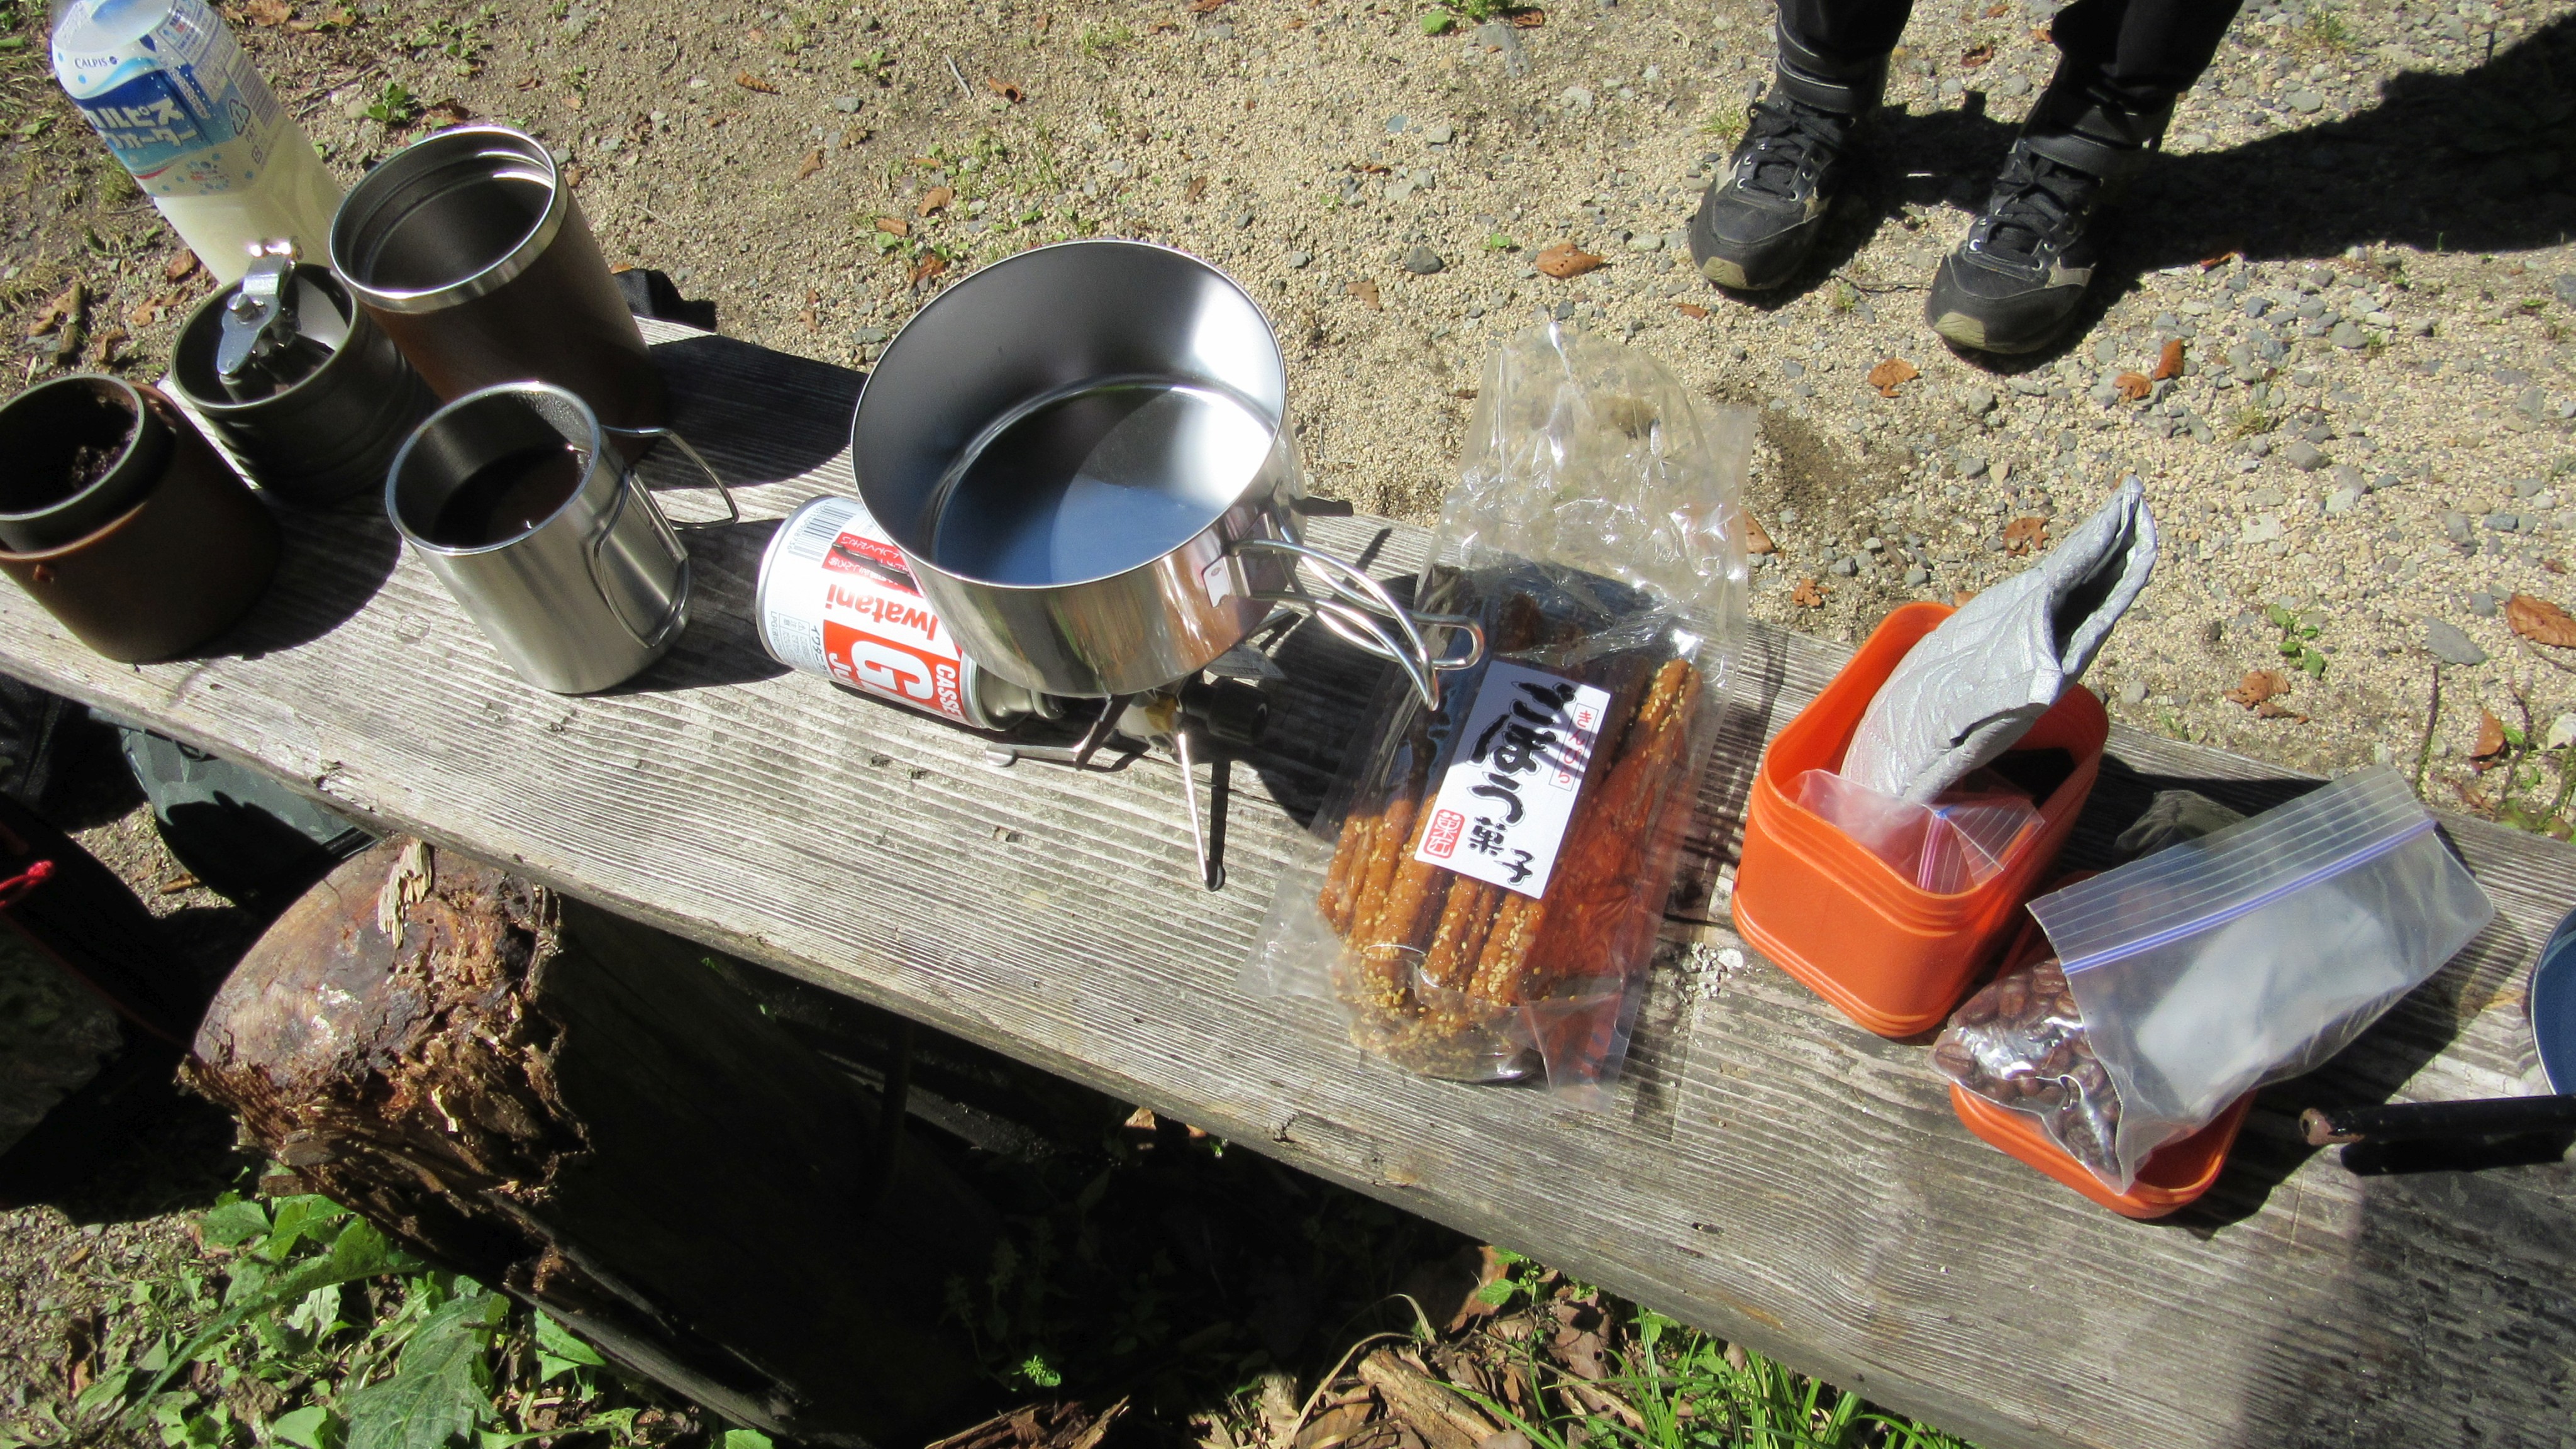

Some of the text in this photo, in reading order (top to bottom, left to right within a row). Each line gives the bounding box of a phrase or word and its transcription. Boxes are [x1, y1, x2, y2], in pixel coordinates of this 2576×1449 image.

[74, 57, 108, 69] CALPIS
[825, 584, 938, 641] Iwatani
[851, 640, 934, 700] G
[936, 663, 962, 717] CASSE
[1557, 709, 1593, 786] きんぴら
[1467, 682, 1576, 885] ごぼう菓子
[1425, 811, 1463, 857] 菓匠
